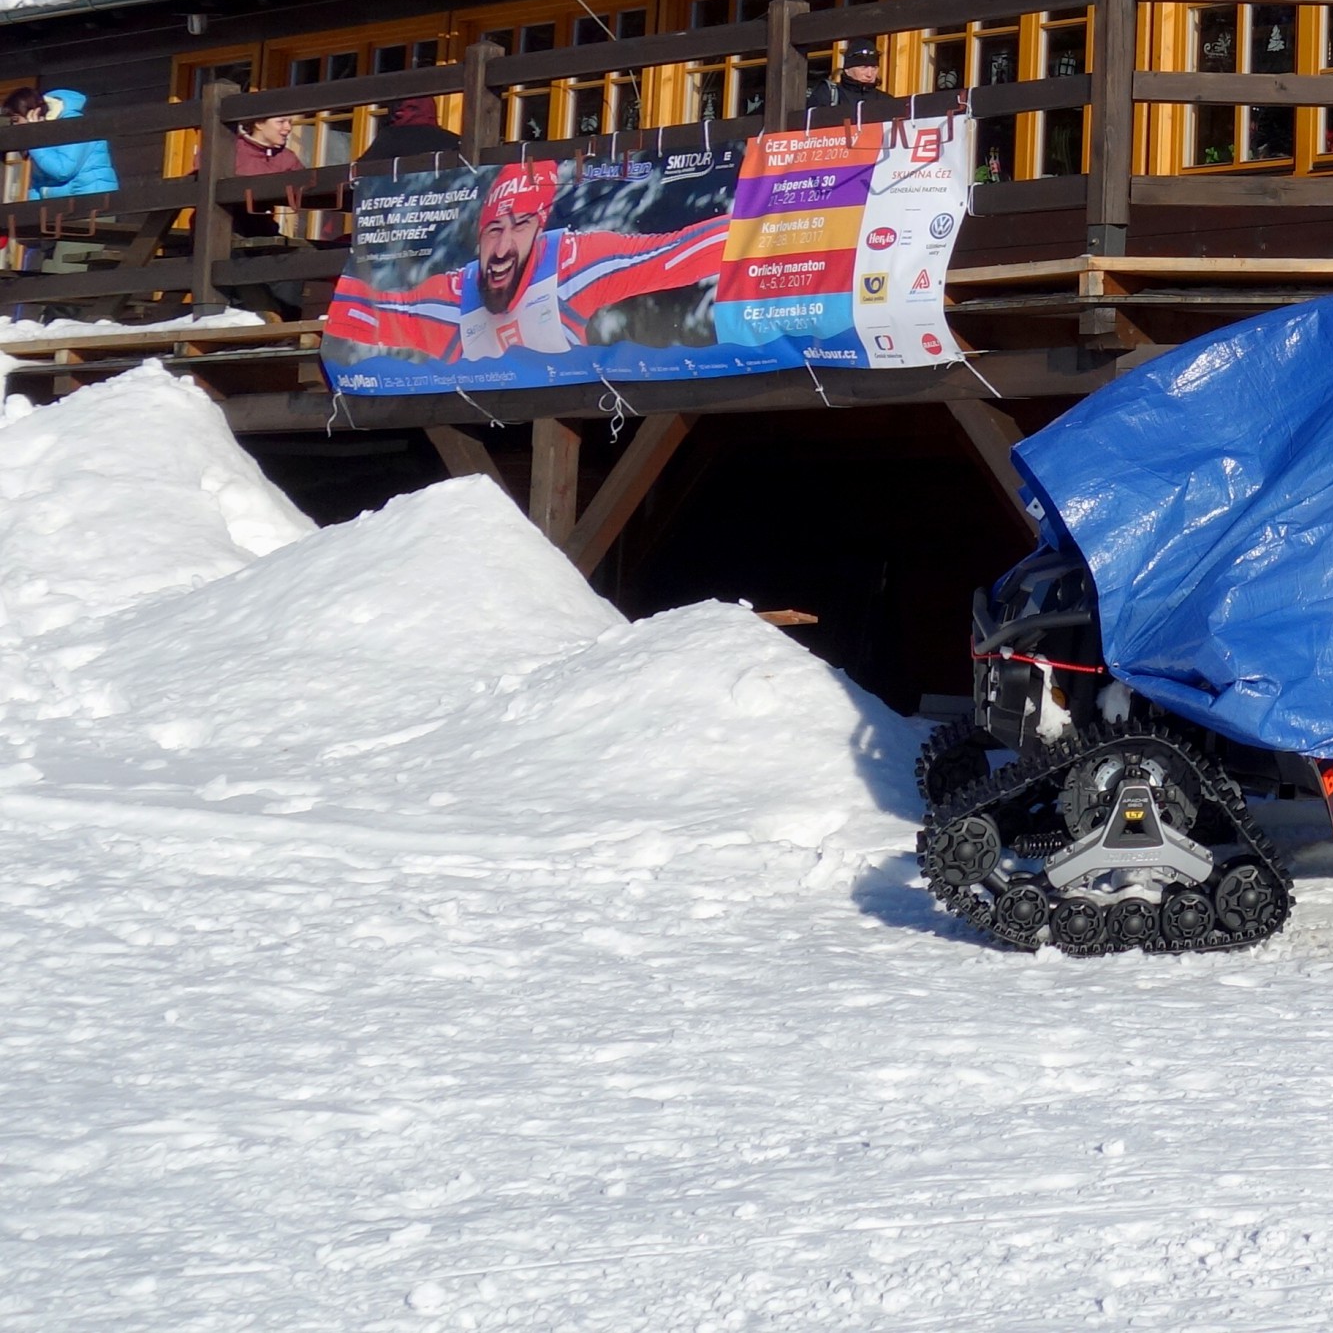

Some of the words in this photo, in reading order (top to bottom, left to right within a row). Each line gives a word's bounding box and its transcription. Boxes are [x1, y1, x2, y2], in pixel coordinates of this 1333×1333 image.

[765, 138, 788, 153] ČEZ
[790, 133, 859, 151] Bedřichovsý
[768, 153, 794, 167] NLM
[891, 170, 932, 179] SKUPINA
[935, 168, 952, 179] ČEZ
[821, 175, 836, 187] 30
[374, 193, 404, 208] STOPĚ
[404, 195, 420, 207] JE
[420, 191, 444, 206] VŽDY
[807, 188, 833, 202] 2017
[387, 214, 401, 224] NA
[762, 220, 810, 234] Karlovská
[811, 217, 825, 228] 50
[748, 263, 783, 277] Orlický
[784, 260, 825, 272] maraton
[788, 274, 812, 287] 2017
[744, 306, 764, 320] ČEZ
[808, 303, 823, 315] 50
[803, 347, 858, 359] ski-tour.cz
